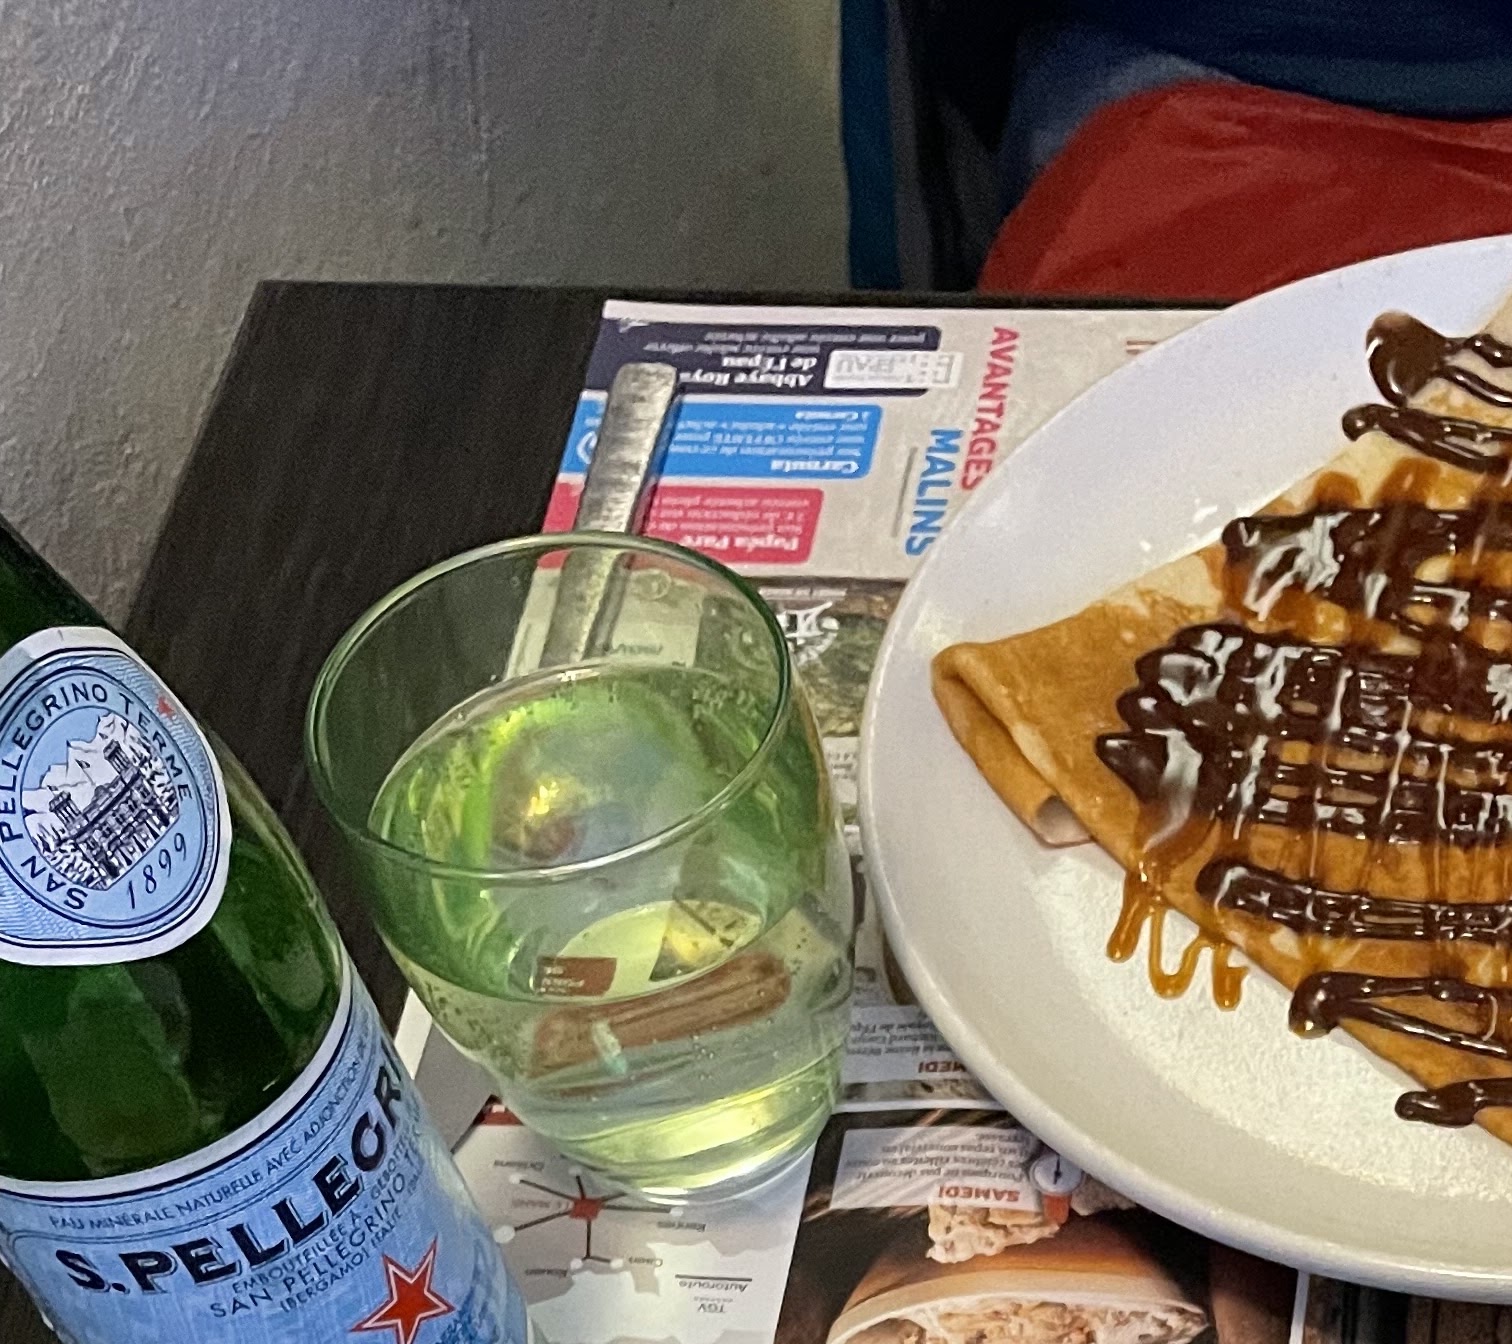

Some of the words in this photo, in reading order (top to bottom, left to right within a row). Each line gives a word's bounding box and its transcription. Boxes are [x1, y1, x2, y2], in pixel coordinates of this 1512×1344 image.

[0, 682, 108, 842] PELLEGRINO
[119, 692, 192, 800] TERME
[21, 856, 88, 910] SAN
[127, 832, 187, 911] 1899
[178, 1172, 262, 1214] NATURELLE
[266, 1138, 300, 1175] AVEC
[938, 1186, 1020, 1202] SAMEDI
[208, 1285, 273, 1318] SAN
[279, 1172, 408, 1294] PELLEGRINO
